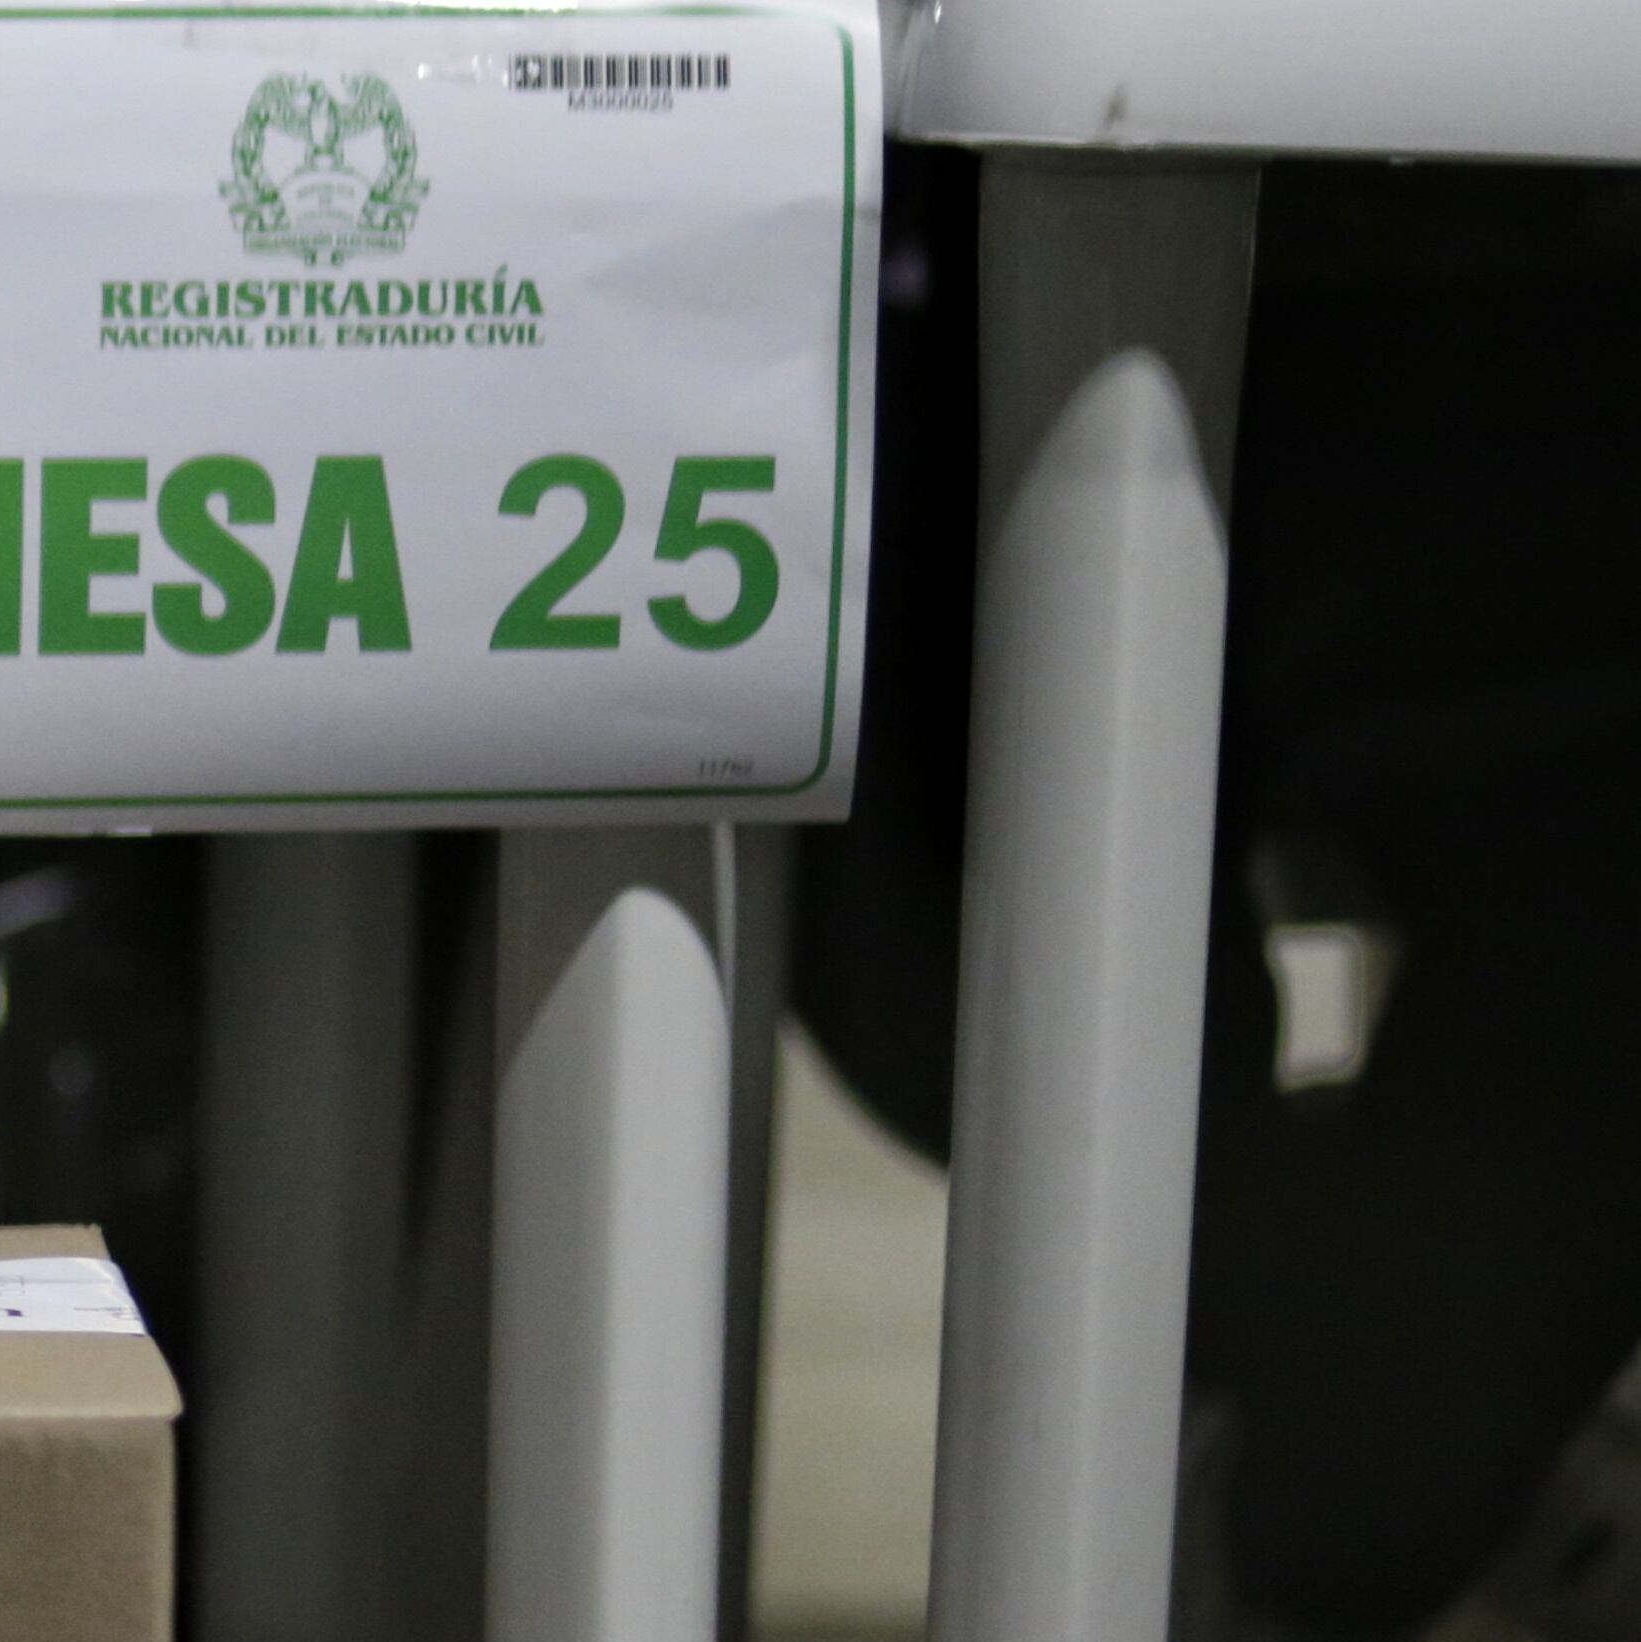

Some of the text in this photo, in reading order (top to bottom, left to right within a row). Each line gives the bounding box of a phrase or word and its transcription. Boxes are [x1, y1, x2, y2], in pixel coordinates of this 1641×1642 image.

[100, 265, 545, 318] REGISTRADURÍA
[100, 321, 546, 349] NACIONAL DEL ESTADO CIVIL
[488, 454, 781, 652] 25
